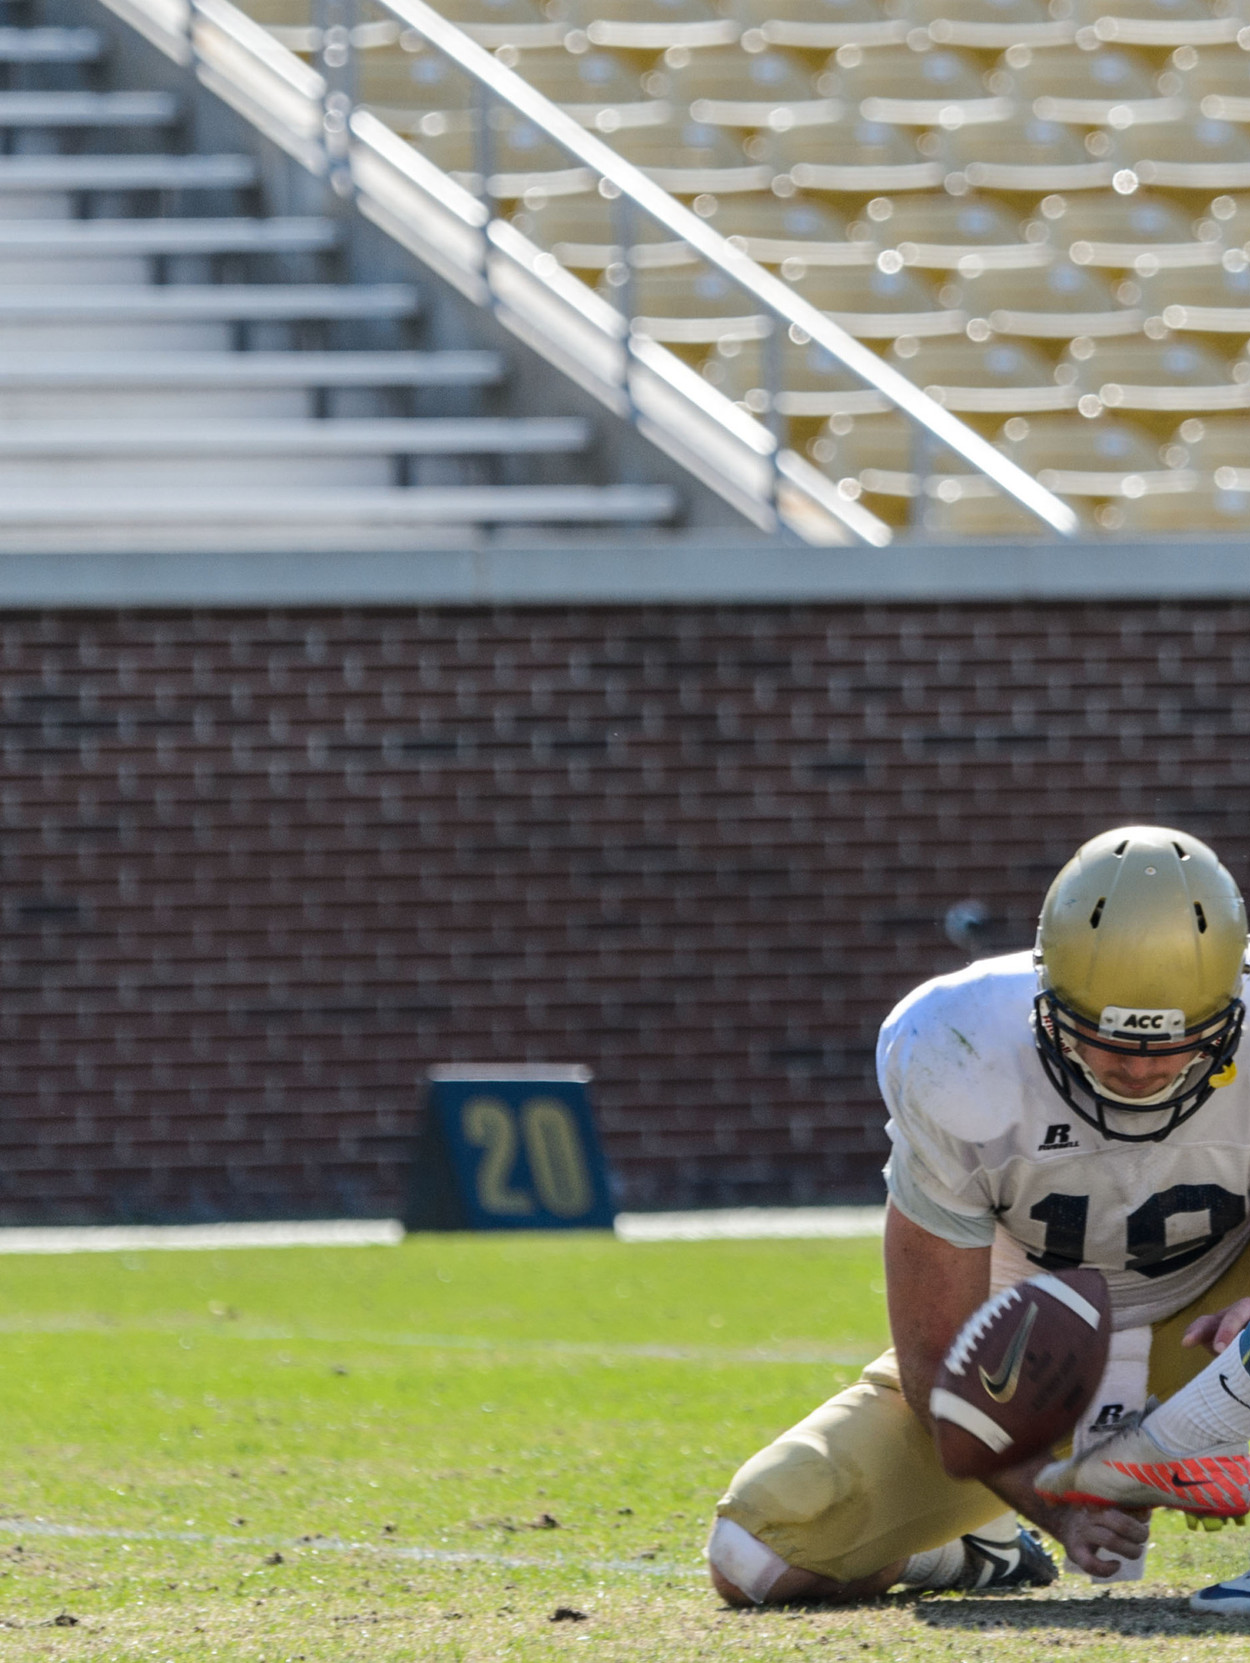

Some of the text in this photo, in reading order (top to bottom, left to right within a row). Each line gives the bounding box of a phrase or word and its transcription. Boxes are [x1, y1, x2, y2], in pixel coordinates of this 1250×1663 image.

[1123, 1014, 1164, 1029] ACC
[1044, 1123, 1071, 1145] R
[461, 1097, 593, 1217] 20
[1095, 1404, 1124, 1425] R
